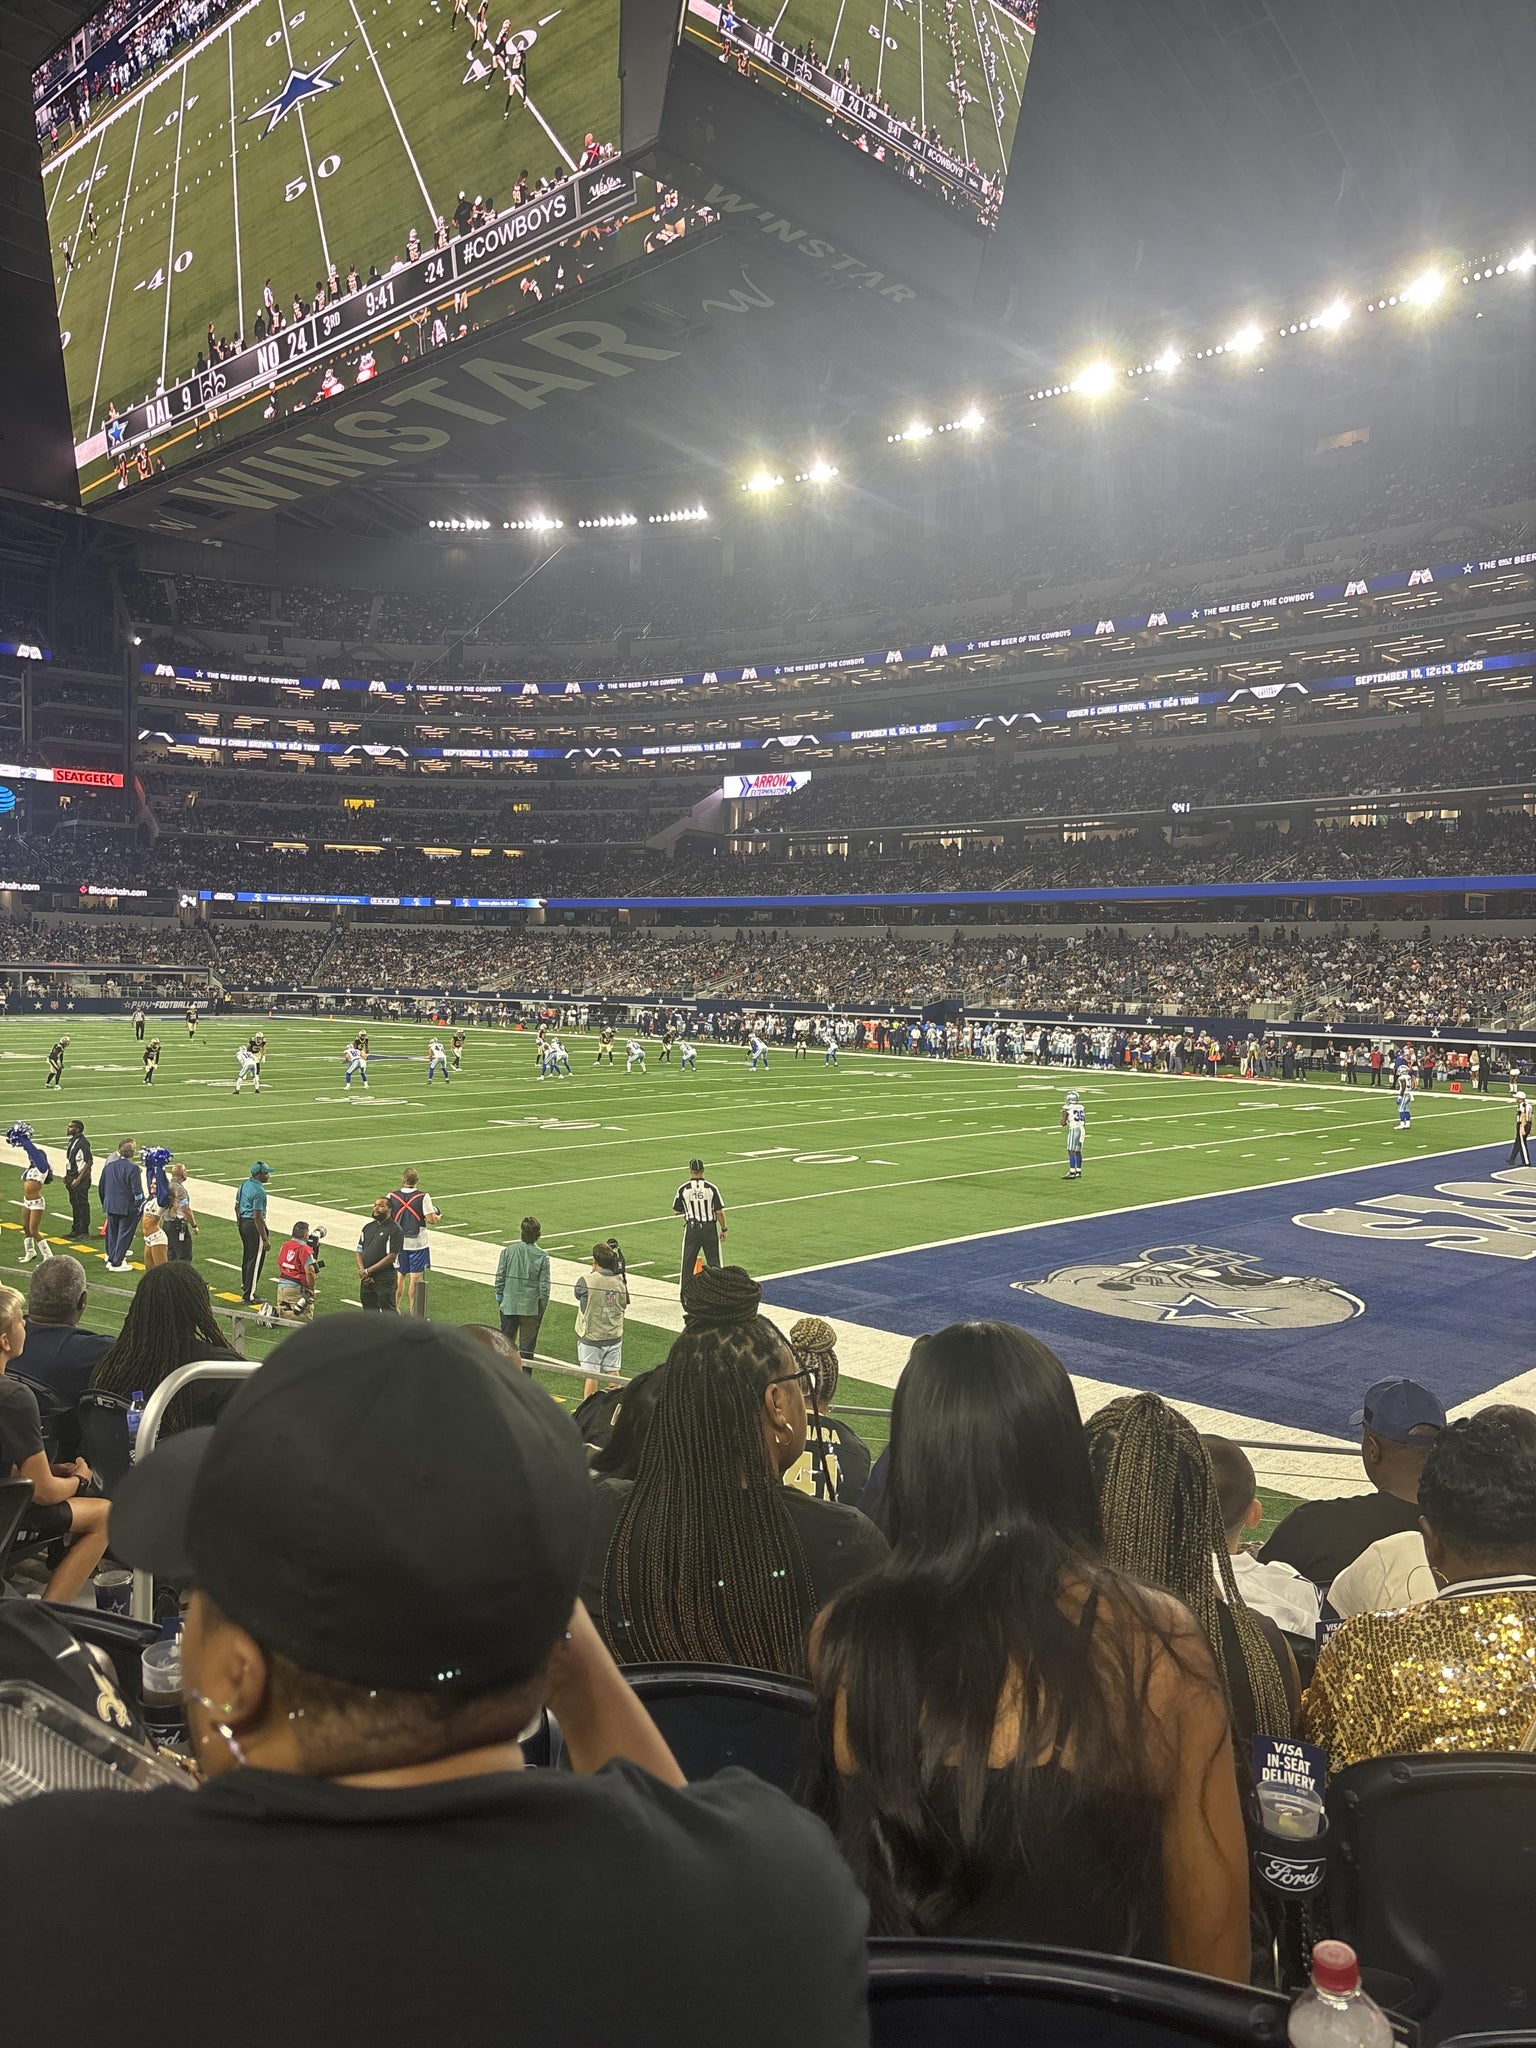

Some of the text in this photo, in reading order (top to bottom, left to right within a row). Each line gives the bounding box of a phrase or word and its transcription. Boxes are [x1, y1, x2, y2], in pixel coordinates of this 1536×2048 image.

[754, 33, 774, 60] DAL
[781, 53, 788, 68] 9
[831, 84, 844, 105] NO
[849, 93, 859, 115] 24
[887, 121, 902, 139] 9:41
[927, 148, 964, 178] #COWBOYS
[284, 154, 342, 202] 50
[703, 183, 917, 304] WINSTAR
[146, 250, 194, 290] 40
[145, 396, 173, 429] DAL
[182, 387, 191, 411] 9
[257, 341, 280, 374] NO
[287, 327, 307, 360] 24
[323, 312, 341, 336] 3RD
[365, 281, 396, 316] 9:41
[424, 258, 445, 285] :24
[463, 195, 567, 264] #COWBOYS
[168, 319, 682, 510] WINSTAR
[1478, 560, 1496, 571] THE
[1514, 553, 1536, 564] BEER
[1204, 607, 1217, 616] THE
[1231, 602, 1250, 612] BEER
[1252, 600, 1261, 609] OF
[1262, 598, 1277, 607] THE
[1278, 592, 1314, 605] COWBOYS
[1392, 621, 1409, 631] DON
[1411, 616, 1445, 628] PERKINS
[978, 641, 989, 649] THE
[1002, 637, 1017, 645] BEER
[1028, 633, 1040, 641] THE
[1042, 629, 1071, 639] COWBOYS
[1254, 642, 1272, 651] LILLY
[839, 657, 864, 666] COWBOYS
[270, 677, 300, 686] COWBOYS
[660, 677, 683, 685] COWBOYS
[1355, 671, 1408, 686] SEPTEMBER
[1410, 669, 1423, 678] 10,
[1456, 661, 1484, 672] 2026
[1066, 709, 1088, 719] USHER
[1097, 706, 1117, 715] CHRIS
[1148, 701, 1162, 709] THE
[1180, 697, 1199, 706] TOUR
[851, 731, 887, 740] SEPTEMBER
[443, 749, 481, 757] SEPTEMBER
[56, 770, 115, 785] SEATGEEK
[753, 773, 789, 788] ARROW
[88, 886, 148, 898] Blockchain.com
[154, 1001, 209, 1009] FOOTBALLCOM
[1452, 1083, 1459, 1091] 10
[1073, 1109, 1085, 1122] 36
[692, 1191, 704, 1200] 16
[1272, 1741, 1304, 1758] VISA
[1267, 1753, 1311, 1775] IN-SEAT
[1262, 1767, 1316, 1791] DELIVERY
[1264, 1858, 1320, 1887] Ford
